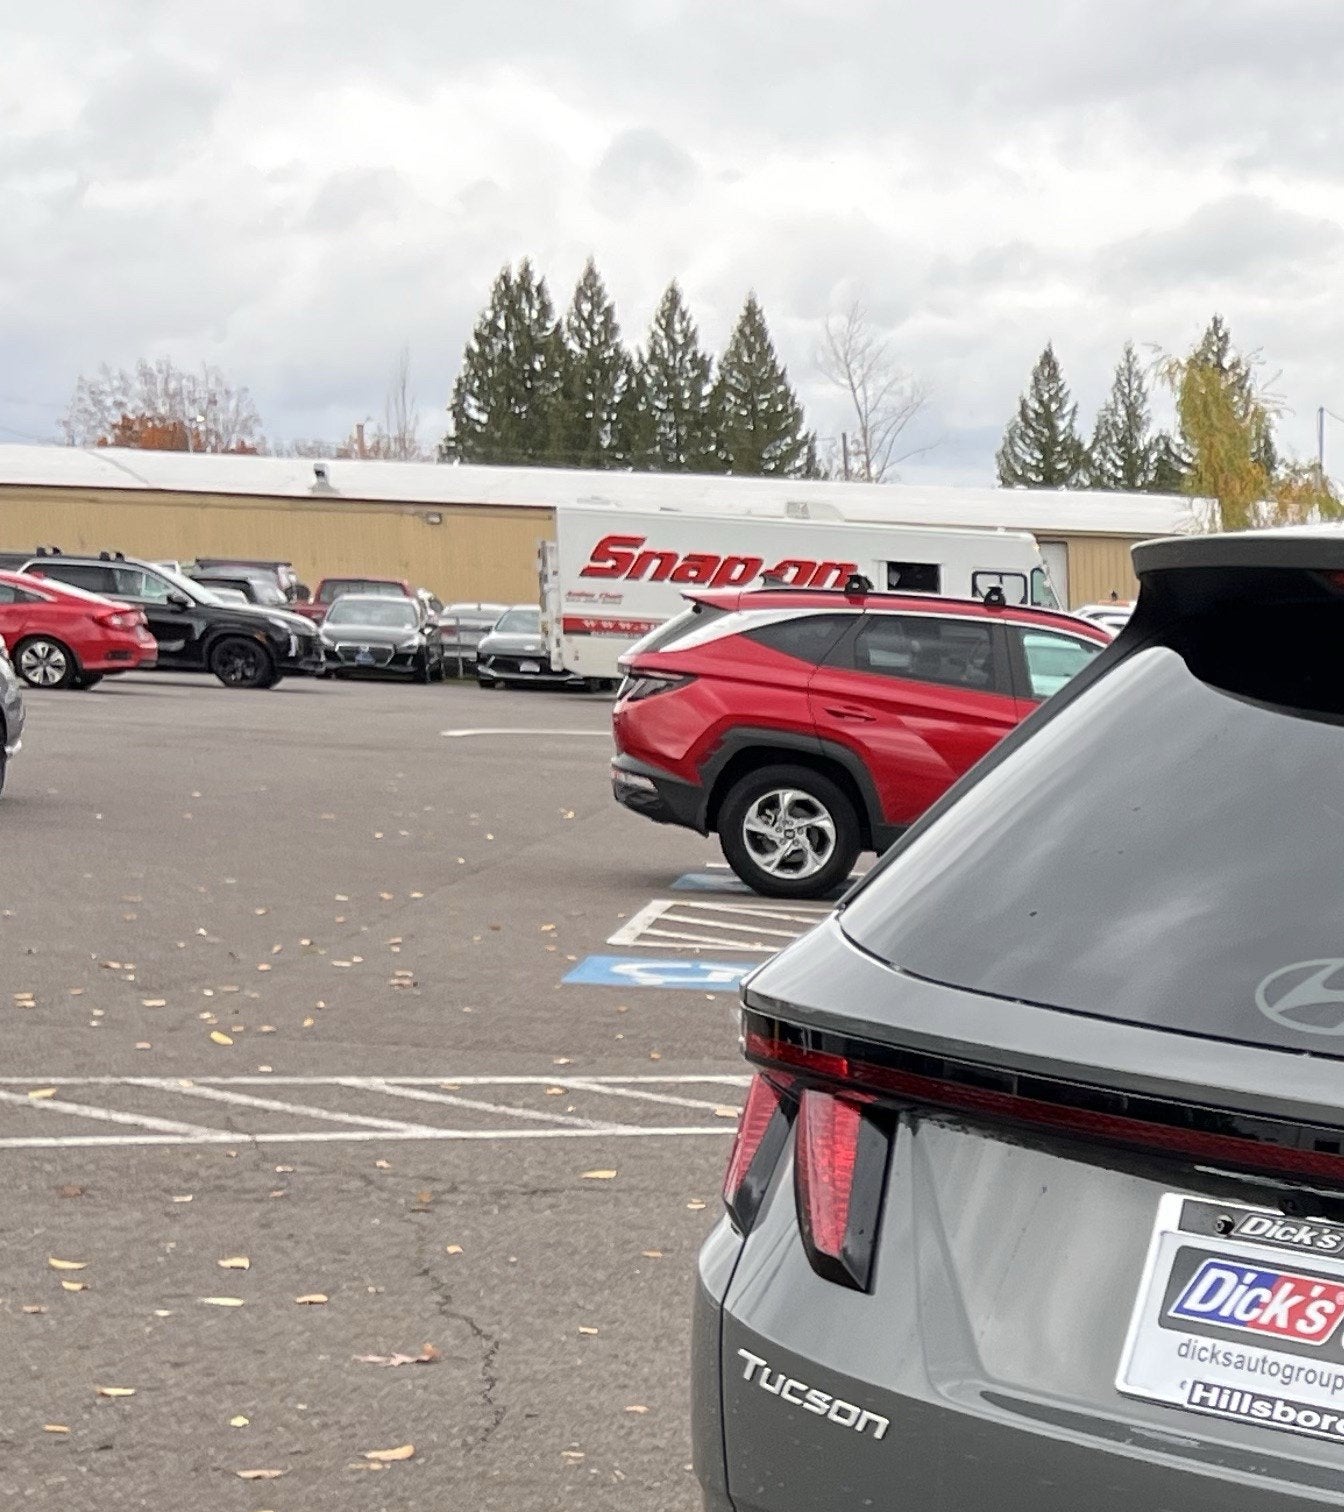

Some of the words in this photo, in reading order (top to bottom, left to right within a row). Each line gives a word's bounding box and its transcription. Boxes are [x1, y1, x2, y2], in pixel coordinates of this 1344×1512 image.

[579, 535, 858, 588] Snap-on
[1239, 1217, 1342, 1249] Dick's
[1183, 1267, 1340, 1335] Dick's
